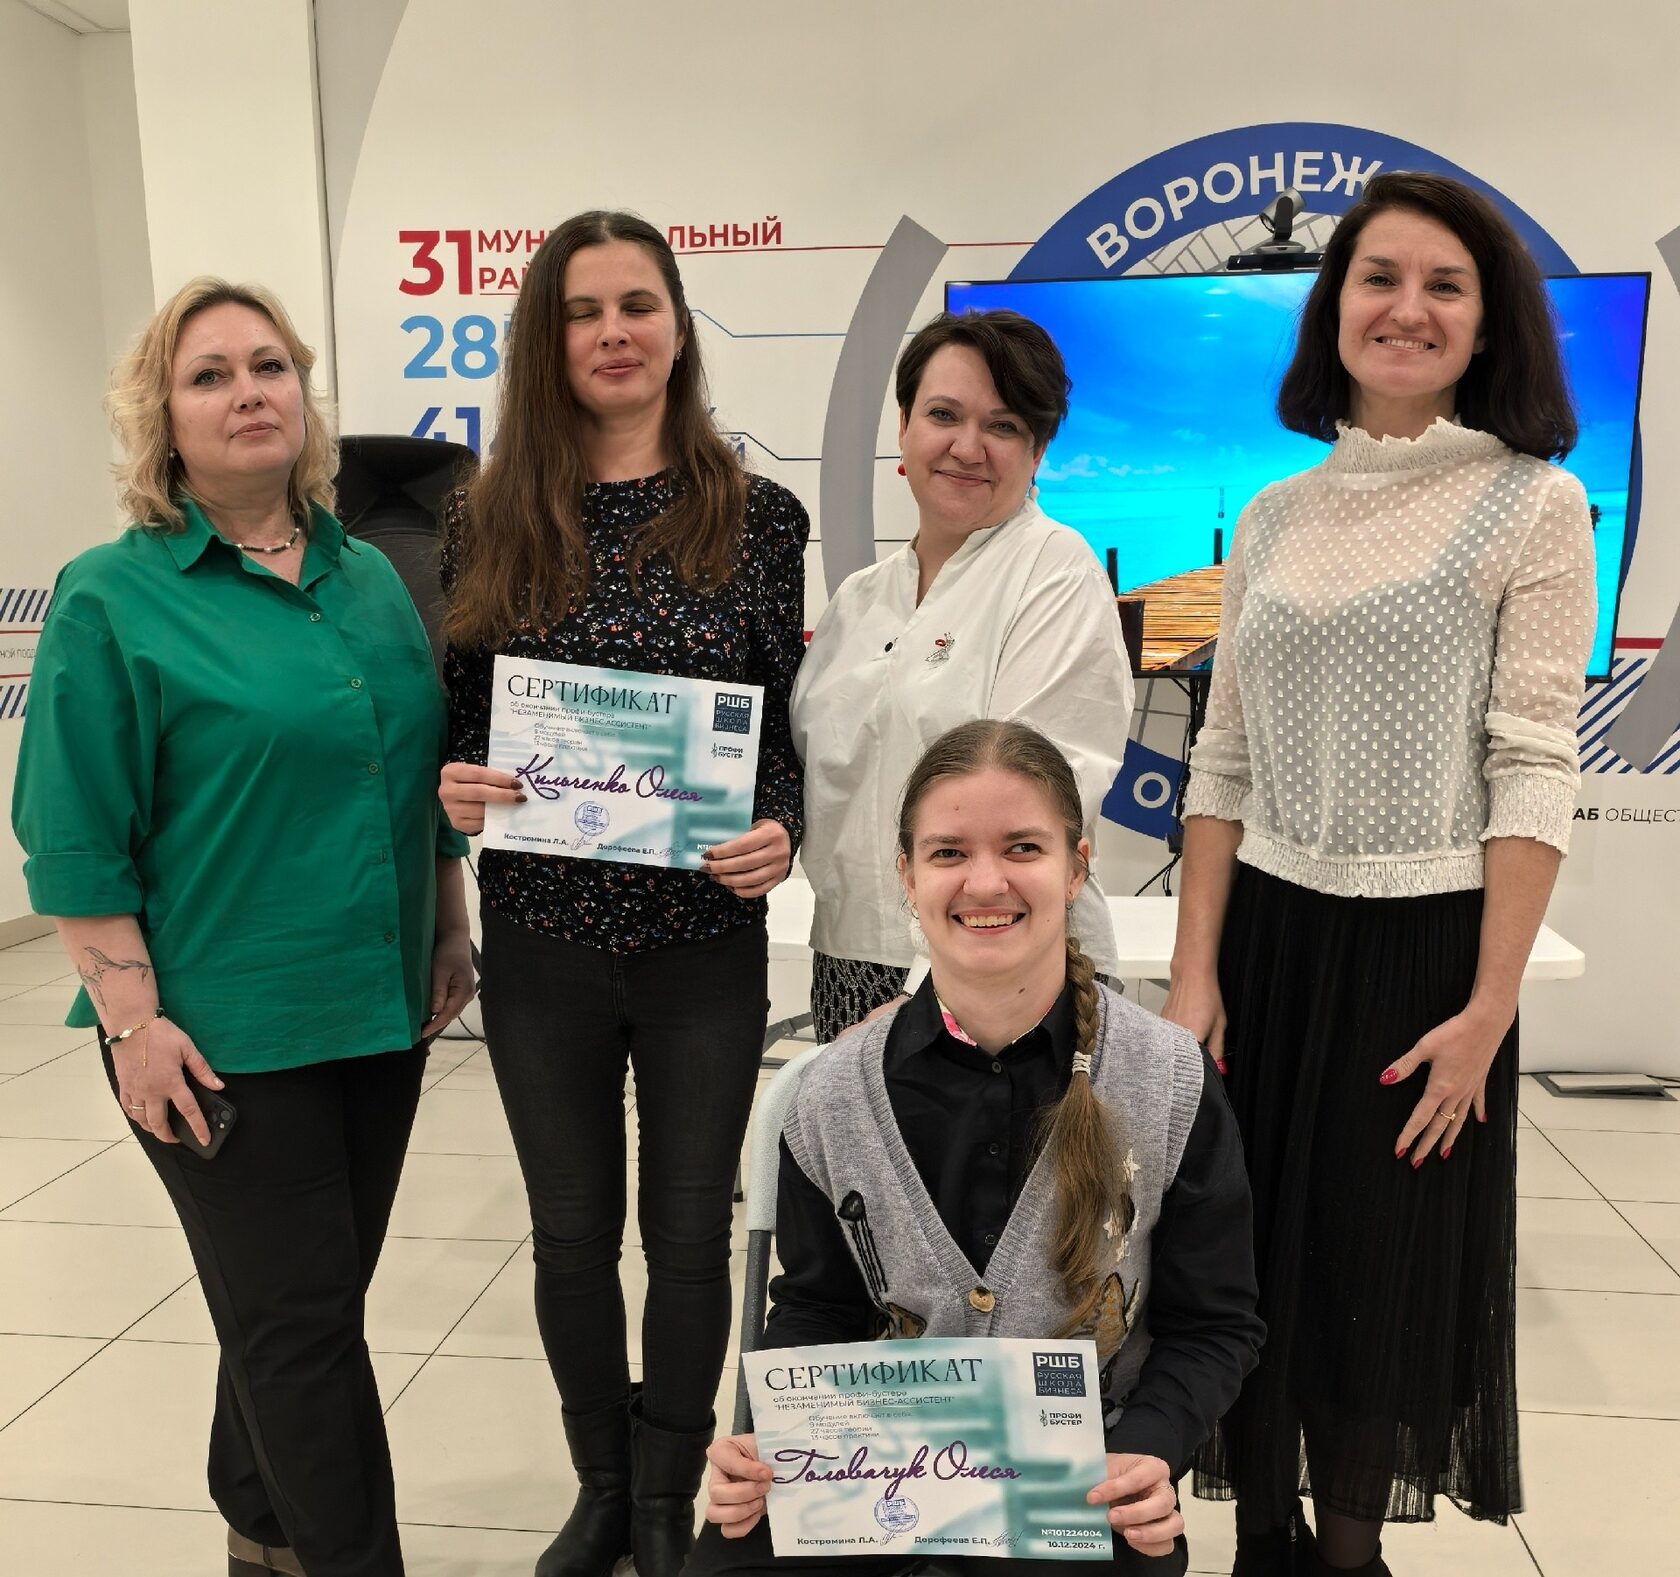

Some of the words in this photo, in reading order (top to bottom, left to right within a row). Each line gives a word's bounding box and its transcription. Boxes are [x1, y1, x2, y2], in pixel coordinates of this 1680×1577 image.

[1086, 151, 1384, 269] ВОРОНЕЖ
[399, 230, 473, 296] 31
[400, 315, 499, 380] 28
[507, 674, 678, 714] СЕРТИФИКАТ
[717, 695, 750, 709] РШБ
[716, 709, 750, 719] РУССКАЯ
[716, 717, 748, 726] ШКОЛА
[515, 754, 631, 800] Кильченко
[636, 765, 703, 802] Олеся
[1572, 807, 1599, 821] АБ
[504, 833, 551, 844] Костромина
[597, 843, 641, 854] Дорофеева
[1036, 1355, 1081, 1369] РШБ
[765, 1358, 983, 1391] СЕРТИФИКАТ
[1037, 1371, 1082, 1380] РУССКАЯ
[1038, 1380, 1082, 1388] ШКОЛА
[1038, 1386, 1083, 1395] БИЗНЕСА
[773, 1395, 785, 1403] об
[786, 1394, 837, 1402] окончании
[838, 1389, 907, 1401] профи-бустера
[772, 1446, 928, 1500] Головачук
[932, 1440, 1022, 1481] Олеся
[797, 1537, 856, 1546] Костромина
[858, 1536, 879, 1544] Л.А.
[914, 1536, 969, 1546] Дорофеева
[972, 1537, 991, 1546] Е.П.
[1047, 1541, 1096, 1550] 10.12.2024
